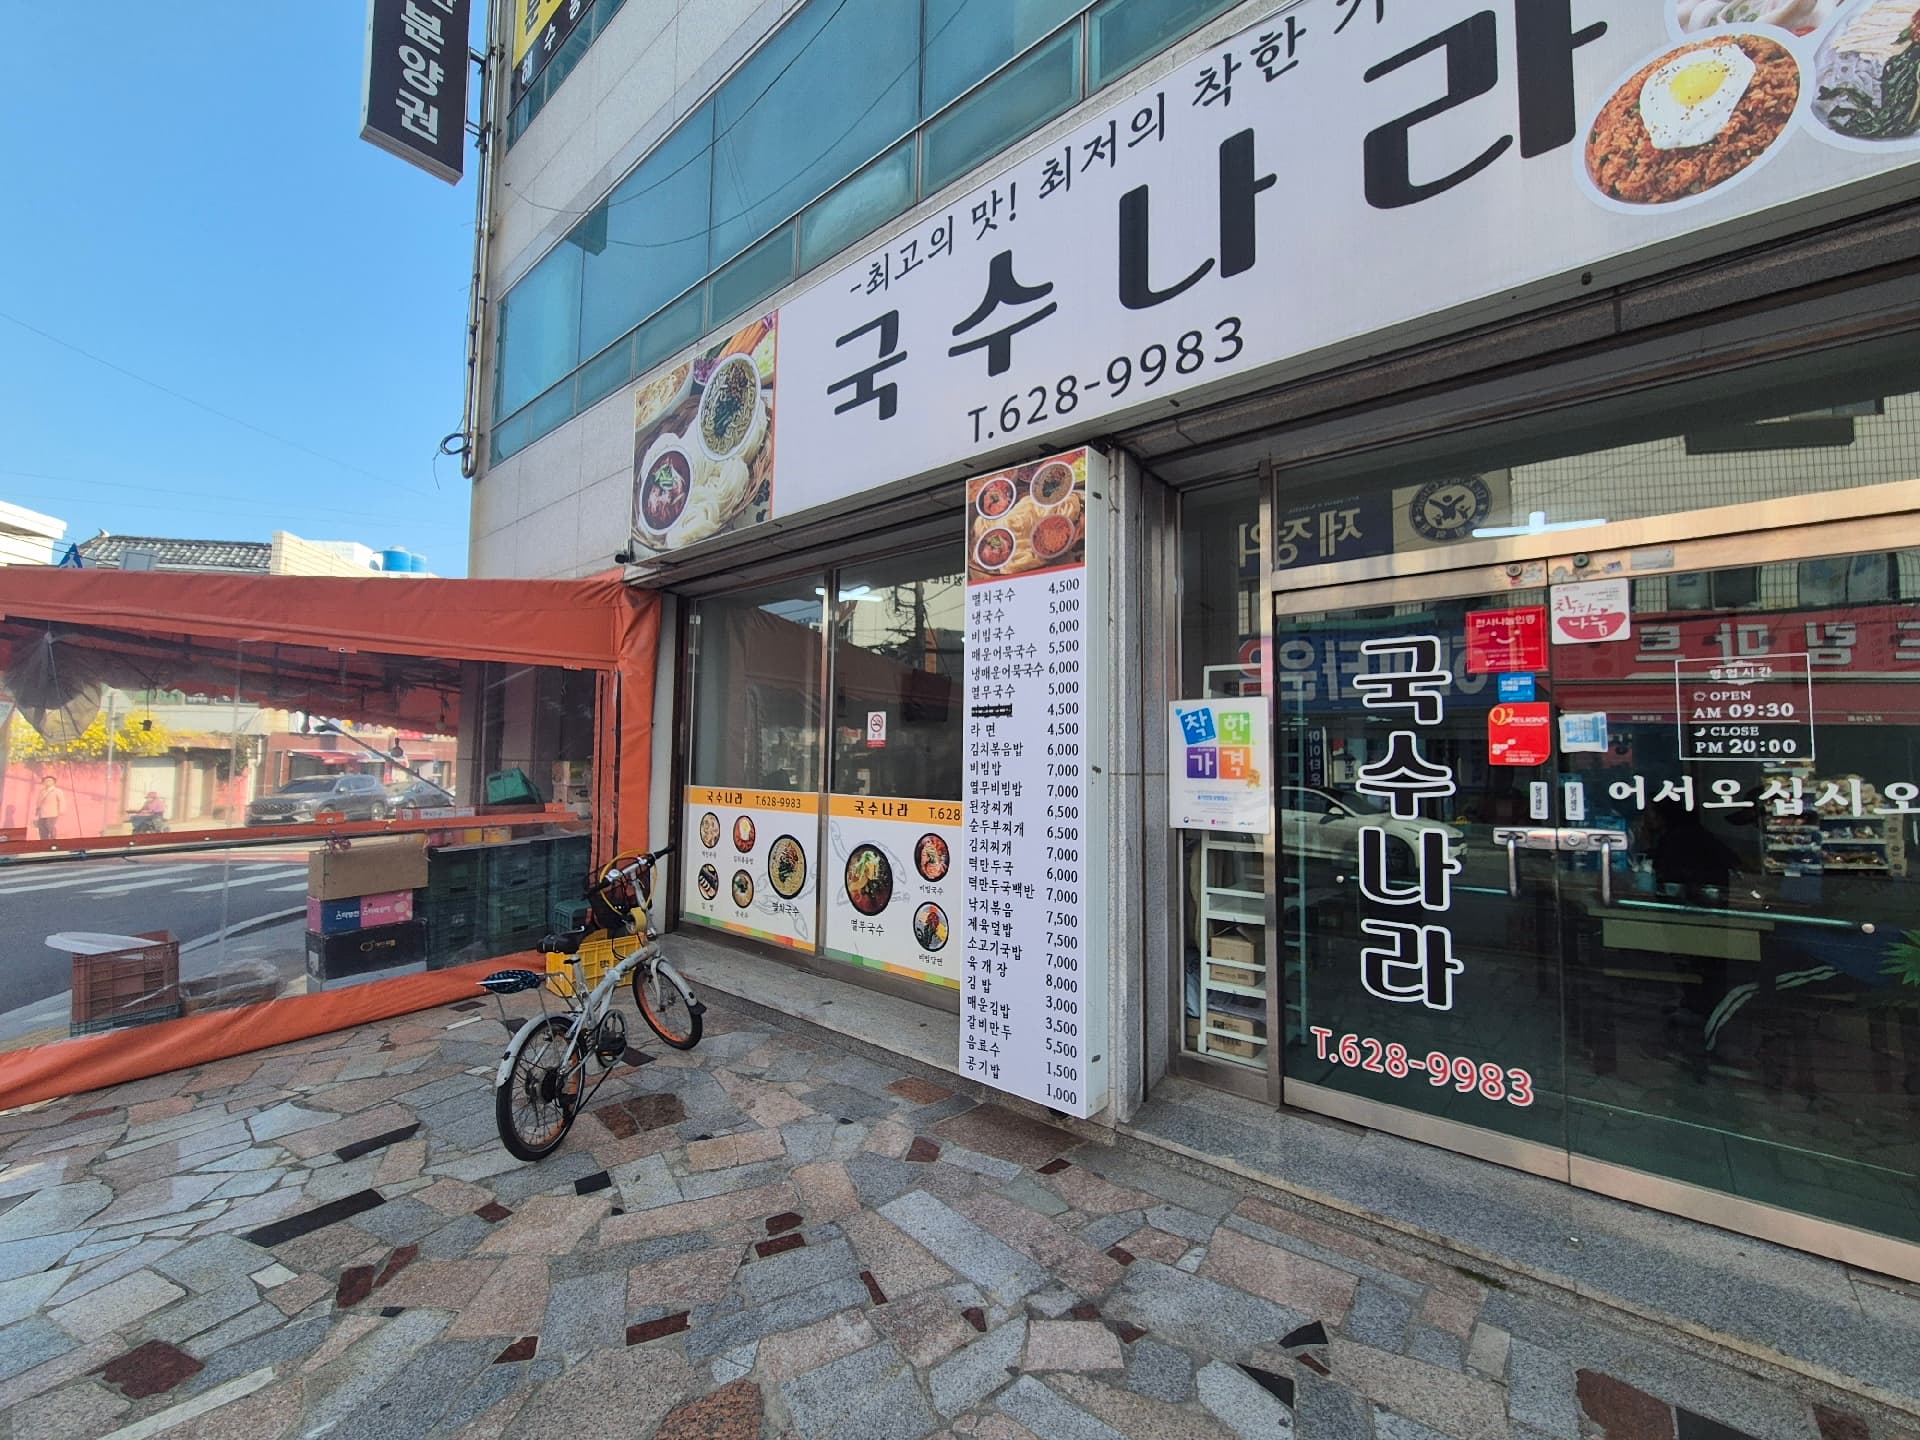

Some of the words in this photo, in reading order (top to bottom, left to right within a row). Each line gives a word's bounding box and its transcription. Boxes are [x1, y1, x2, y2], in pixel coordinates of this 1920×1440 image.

[970, 182, 1018, 241] 맛!
[1038, 92, 1166, 199] 최저의
[1192, 15, 1306, 107] 착한
[827, 0, 1607, 420] 국수나라
[968, 316, 1244, 443] T.628-9983
[972, 588, 1016, 606] 멸치국수
[1049, 578, 1080, 594] 4,500
[972, 608, 1005, 625] 냉국수
[1049, 599, 1080, 615] 5,000
[971, 626, 1016, 644] 비빔국수
[1049, 619, 1080, 635] 6,000
[971, 643, 1038, 661] 매운어묵국수
[1049, 640, 1080, 655] 5,500
[971, 661, 1045, 681] 냉매운어묵국수
[1049, 660, 1080, 675] 6,000
[971, 683, 1016, 700] 열무국수
[1048, 681, 1079, 696] 5,000
[1710, 690, 1751, 701] OPEN
[1048, 702, 1079, 716] 4,500
[1693, 707, 1722, 719] AM
[1728, 702, 1795, 718] 09:30
[1047, 722, 1079, 737] 4,500
[1710, 726, 1760, 737] CLOSE
[970, 741, 1024, 757] 김치볶음밥
[1047, 743, 1079, 757] 6,000
[1695, 741, 1723, 754] PM
[1728, 738, 1797, 754] 20:00
[970, 760, 1002, 776] 비빔밥
[1047, 763, 1079, 778] 7,000
[706, 791, 744, 806] 국수나라
[755, 795, 802, 809] T.628-9983
[969, 780, 1023, 798] 열무비빔밥
[1047, 784, 1079, 799] 7,000
[853, 799, 910, 818] 국수나라
[969, 799, 1013, 817] 된장찌개
[1047, 805, 1079, 820] 6,500
[969, 818, 1025, 838] 순두부찌개
[1047, 826, 1079, 841] 6,500
[1353, 635, 1463, 1011] 국수나라
[969, 837, 1012, 856] 김치찌개
[1047, 846, 1078, 862] 7,000
[968, 856, 1014, 877] 떡만두국
[1046, 867, 1078, 883] 6,000
[968, 876, 1036, 899] 떡만두국백반
[1046, 887, 1078, 905] 7,000
[968, 897, 1014, 919] 낙지볶음
[1046, 910, 1078, 928] 7,500
[850, 919, 886, 938] 열무국수
[967, 916, 1014, 938] 제육덮밥
[1046, 932, 1078, 950] 7,500
[967, 936, 1024, 961] 소고기국밥
[1046, 953, 1078, 972] 7,000
[1045, 974, 1078, 993] 8,000
[967, 996, 1012, 1020] 매운김밥
[1045, 1016, 1078, 1037] 3,500
[1045, 995, 1078, 1015] 3,000
[966, 1015, 1013, 1041] 갈비만두
[1045, 1038, 1078, 1059] 5,500
[966, 1035, 1001, 1058] 음료수
[1046, 1061, 1077, 1082] 1,500
[1309, 1025, 1534, 1107] T.628-9983
[965, 1055, 1001, 1080] 공기밥
[1045, 1083, 1077, 1105] 1,000
